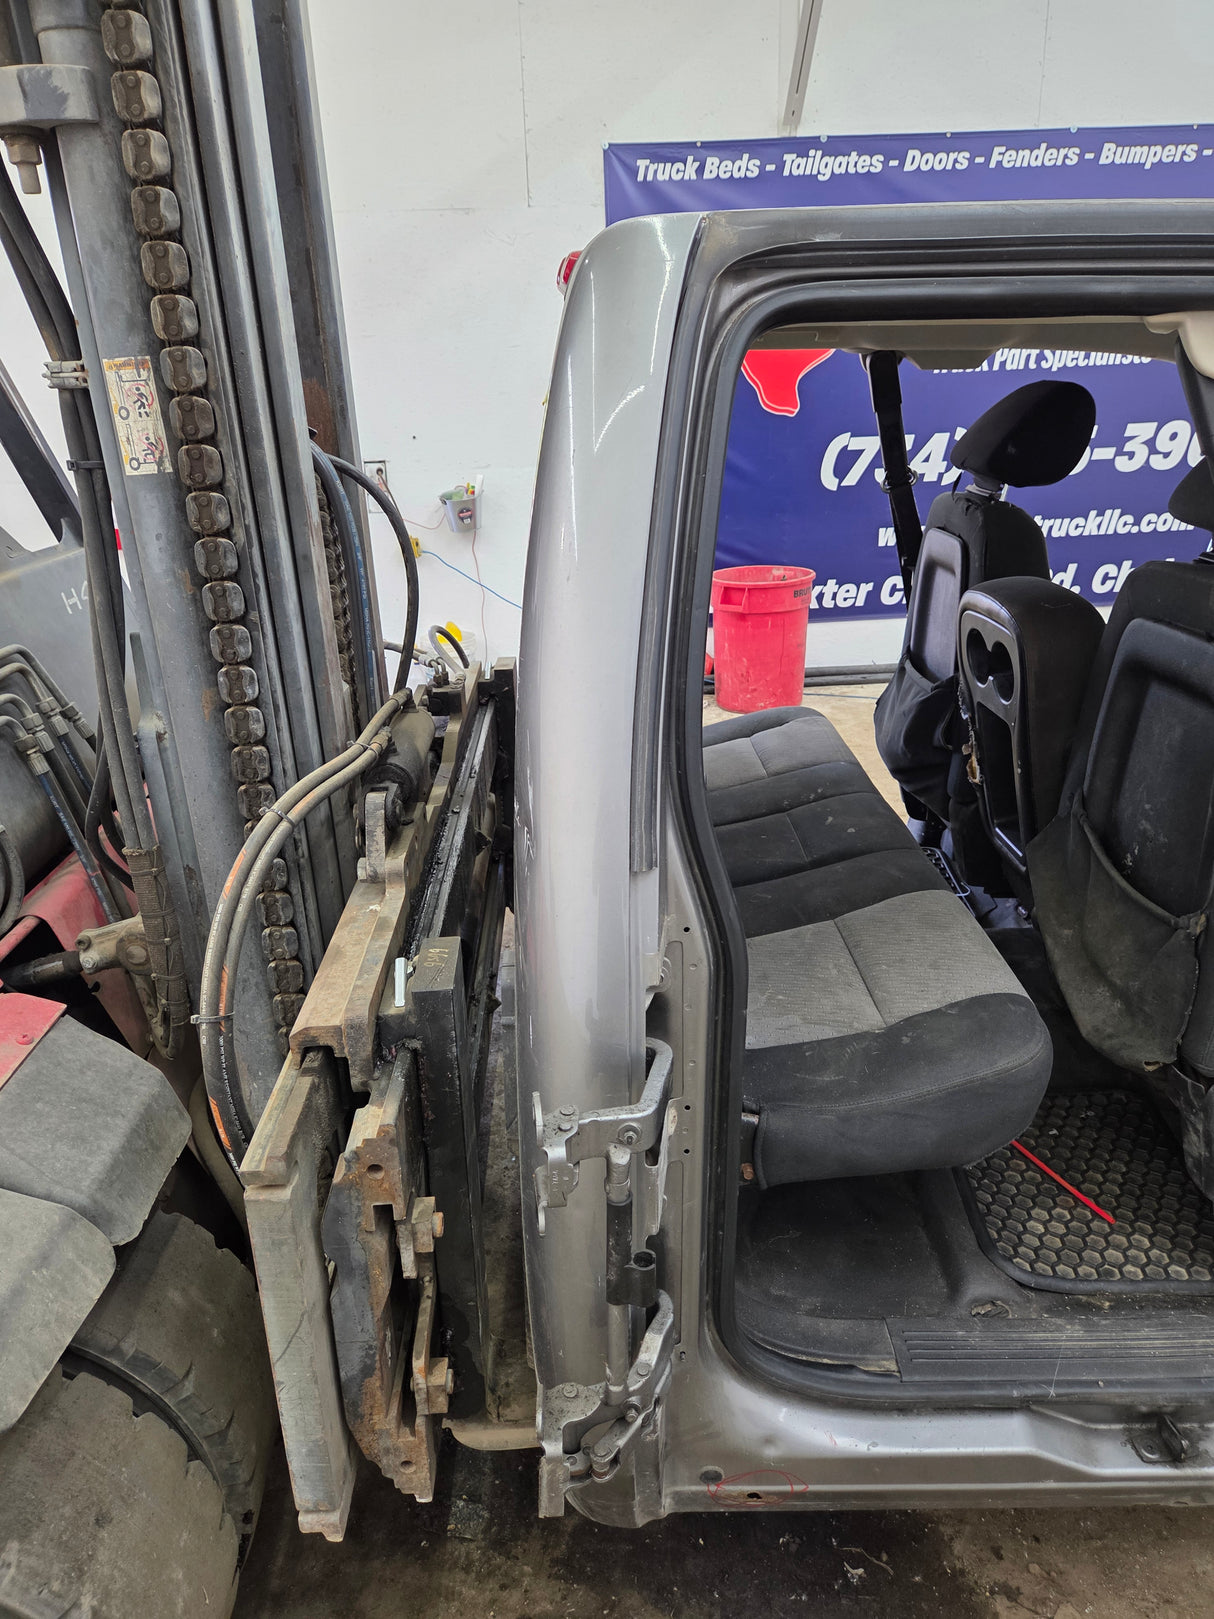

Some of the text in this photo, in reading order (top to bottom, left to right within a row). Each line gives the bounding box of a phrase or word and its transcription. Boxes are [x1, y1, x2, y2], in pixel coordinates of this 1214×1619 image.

[636, 156, 701, 182] Truck
[703, 153, 761, 180] Beds
[782, 149, 884, 181] Tailgates
[903, 149, 970, 172] Doors
[989, 142, 1081, 169] Fenders
[1099, 141, 1198, 170] Bumpers
[992, 348, 1041, 371] Part
[809, 579, 874, 610] xter
